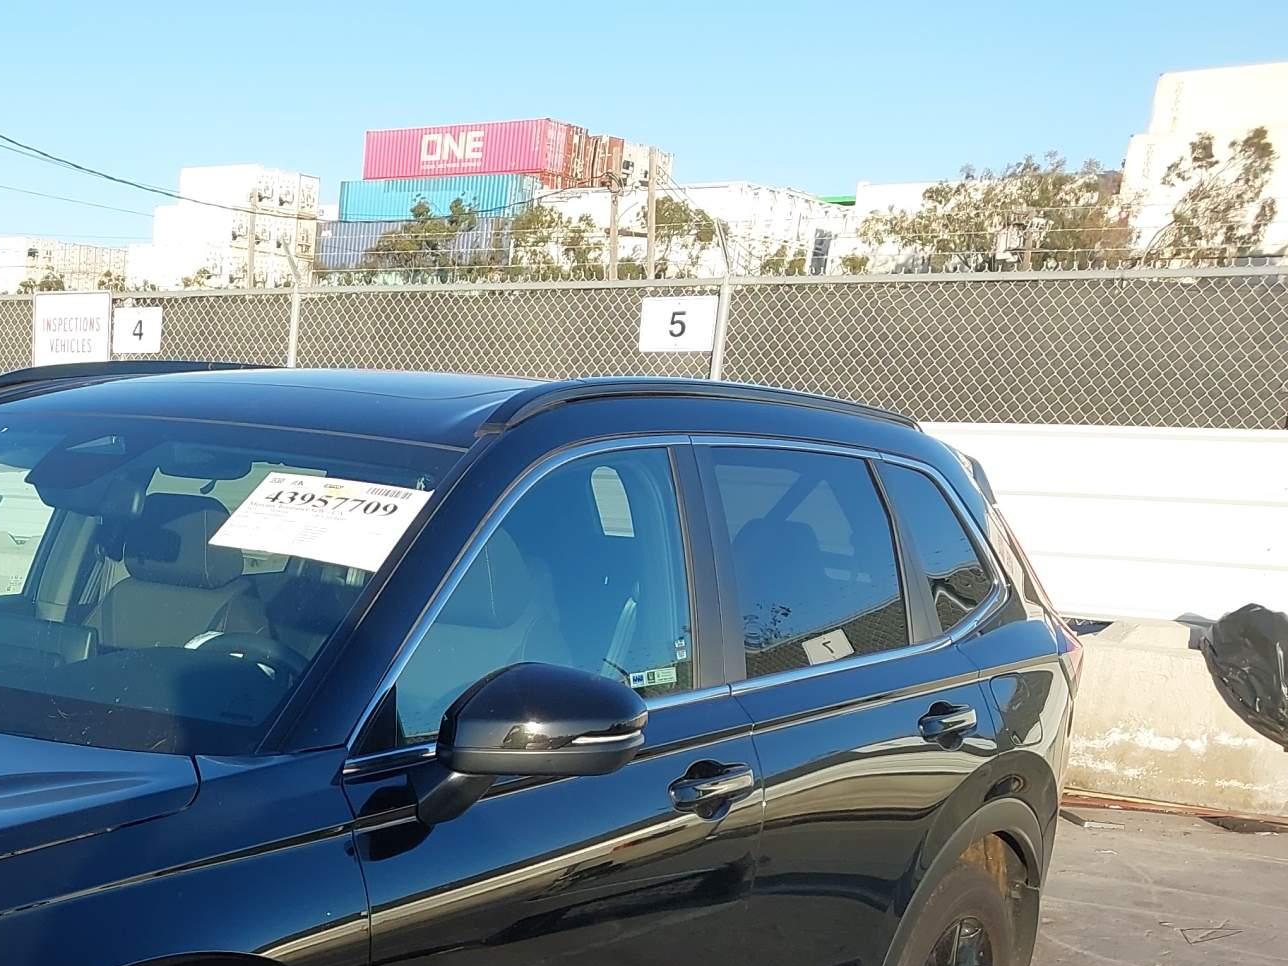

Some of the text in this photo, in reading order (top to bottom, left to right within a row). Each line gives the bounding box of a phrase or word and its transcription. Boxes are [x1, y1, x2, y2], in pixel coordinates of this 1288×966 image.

[420, 130, 484, 161] ONE
[42, 317, 101, 333] INSPECTIONS
[132, 320, 143, 341] 4
[669, 311, 686, 337] 5
[48, 338, 93, 354] VEHICLES
[264, 490, 399, 517] 43957709
